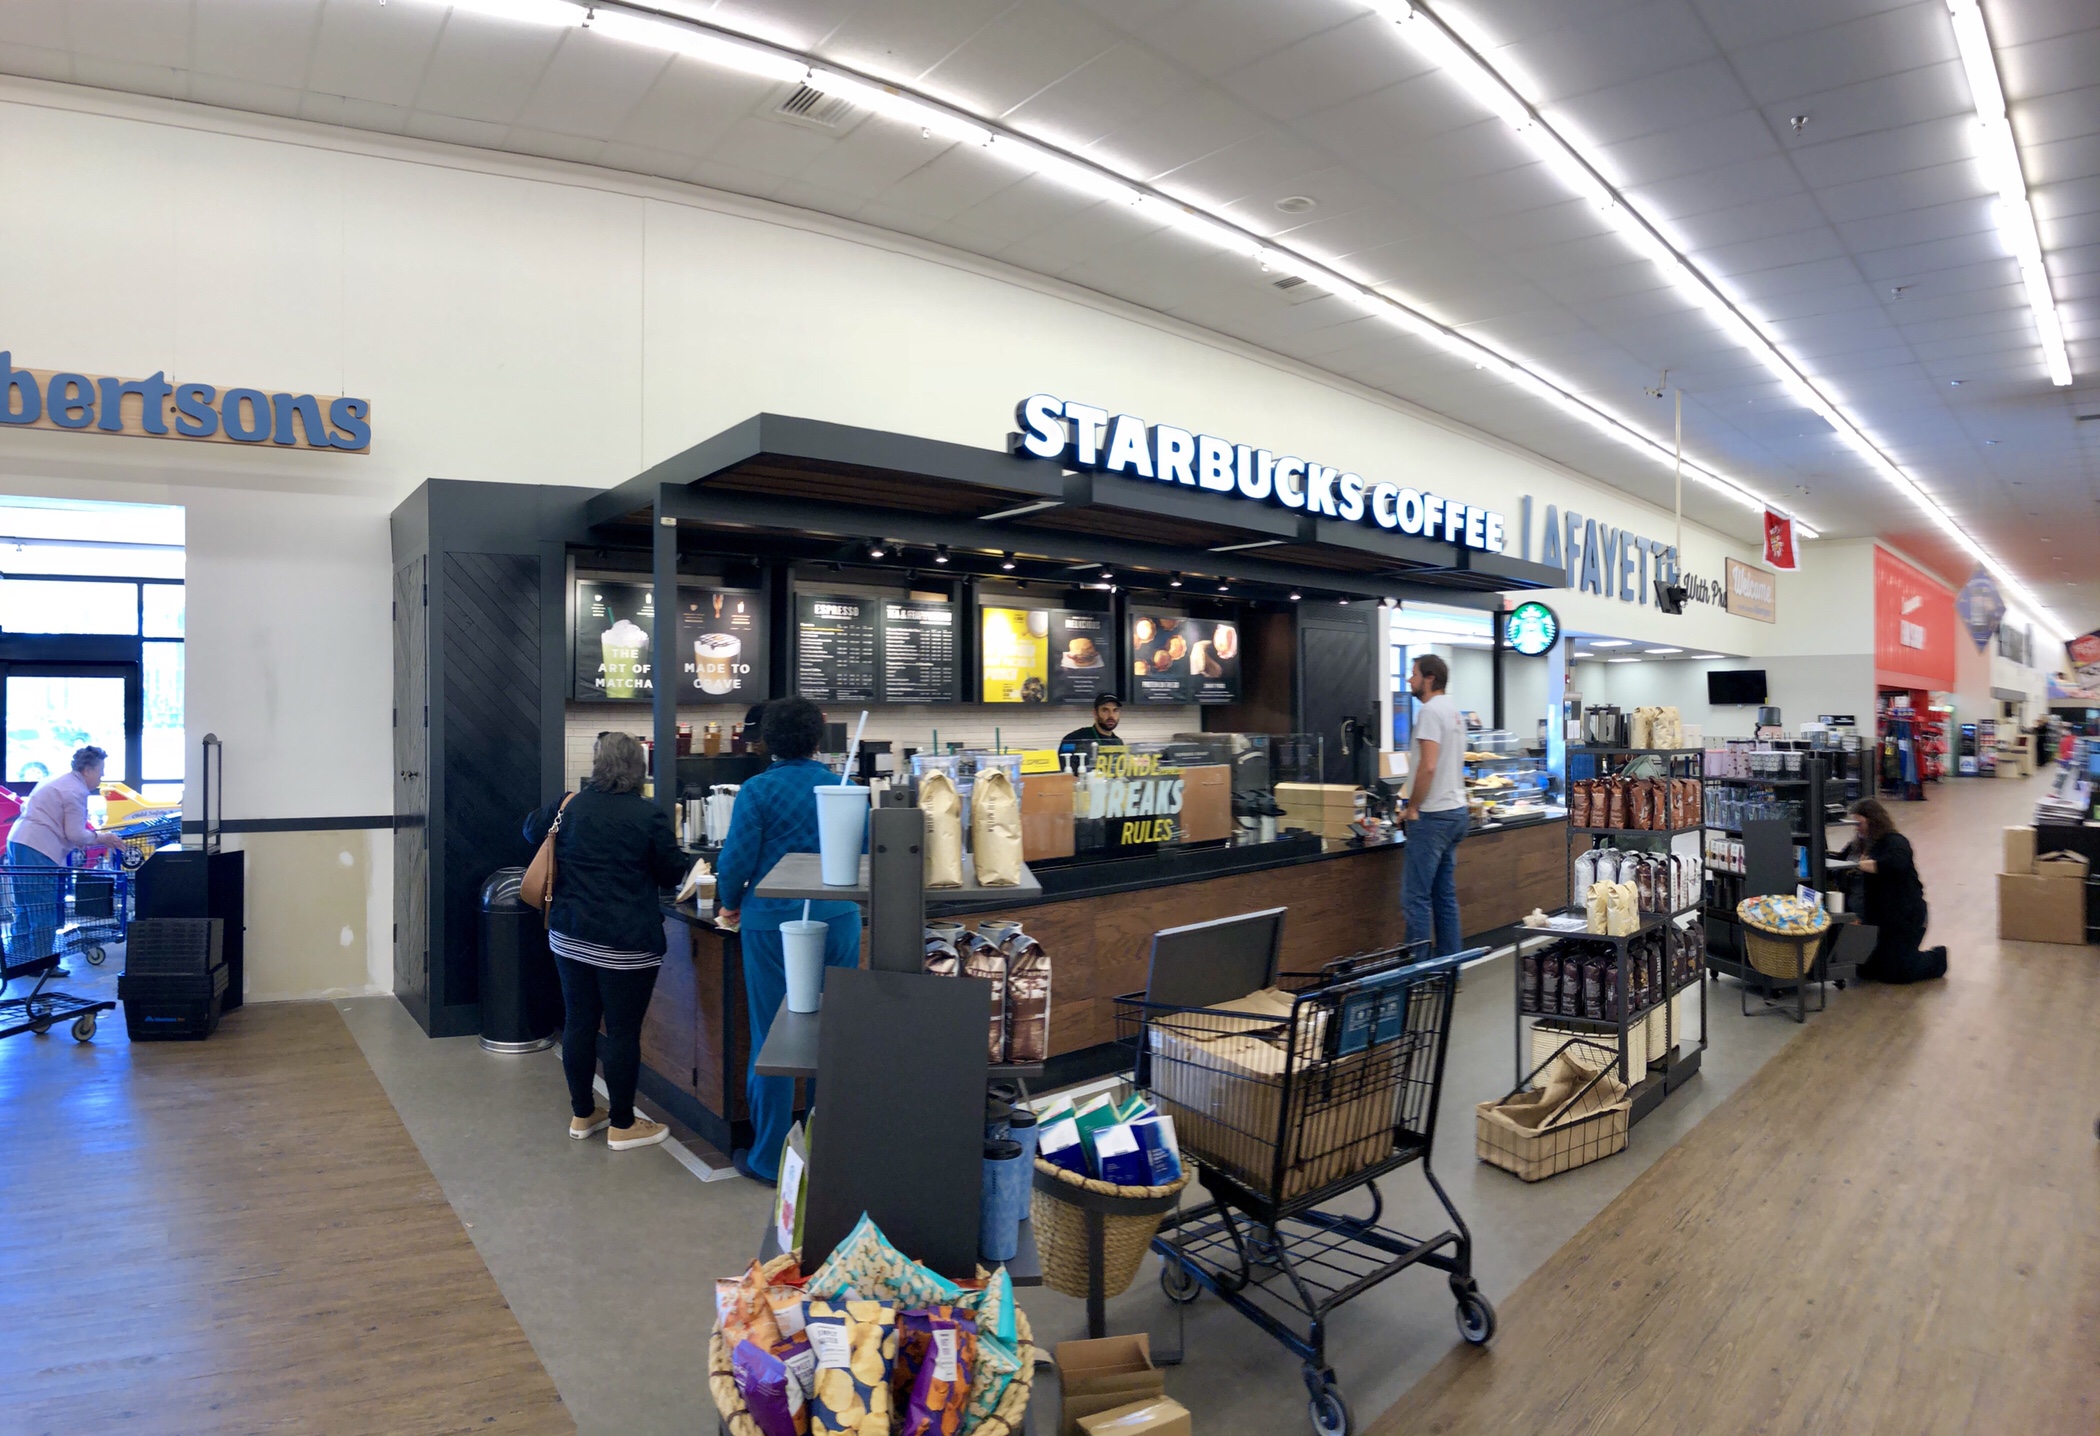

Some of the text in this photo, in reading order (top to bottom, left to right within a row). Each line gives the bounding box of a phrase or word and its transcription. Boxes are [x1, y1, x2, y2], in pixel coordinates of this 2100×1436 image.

[0, 351, 371, 450] bertsons
[1017, 394, 1505, 552] STARBUCKS COFFEE
[1733, 565, 1771, 604] Welcome
[814, 604, 860, 616] ESPRESSO
[612, 649, 639, 659] THE
[598, 663, 651, 674] ART OF
[684, 663, 750, 674] MADE TO
[595, 678, 653, 689] MATCHA
[693, 679, 742, 689] CRAVE
[1095, 753, 1163, 778] BLONDE
[1121, 819, 1173, 845] RULES
